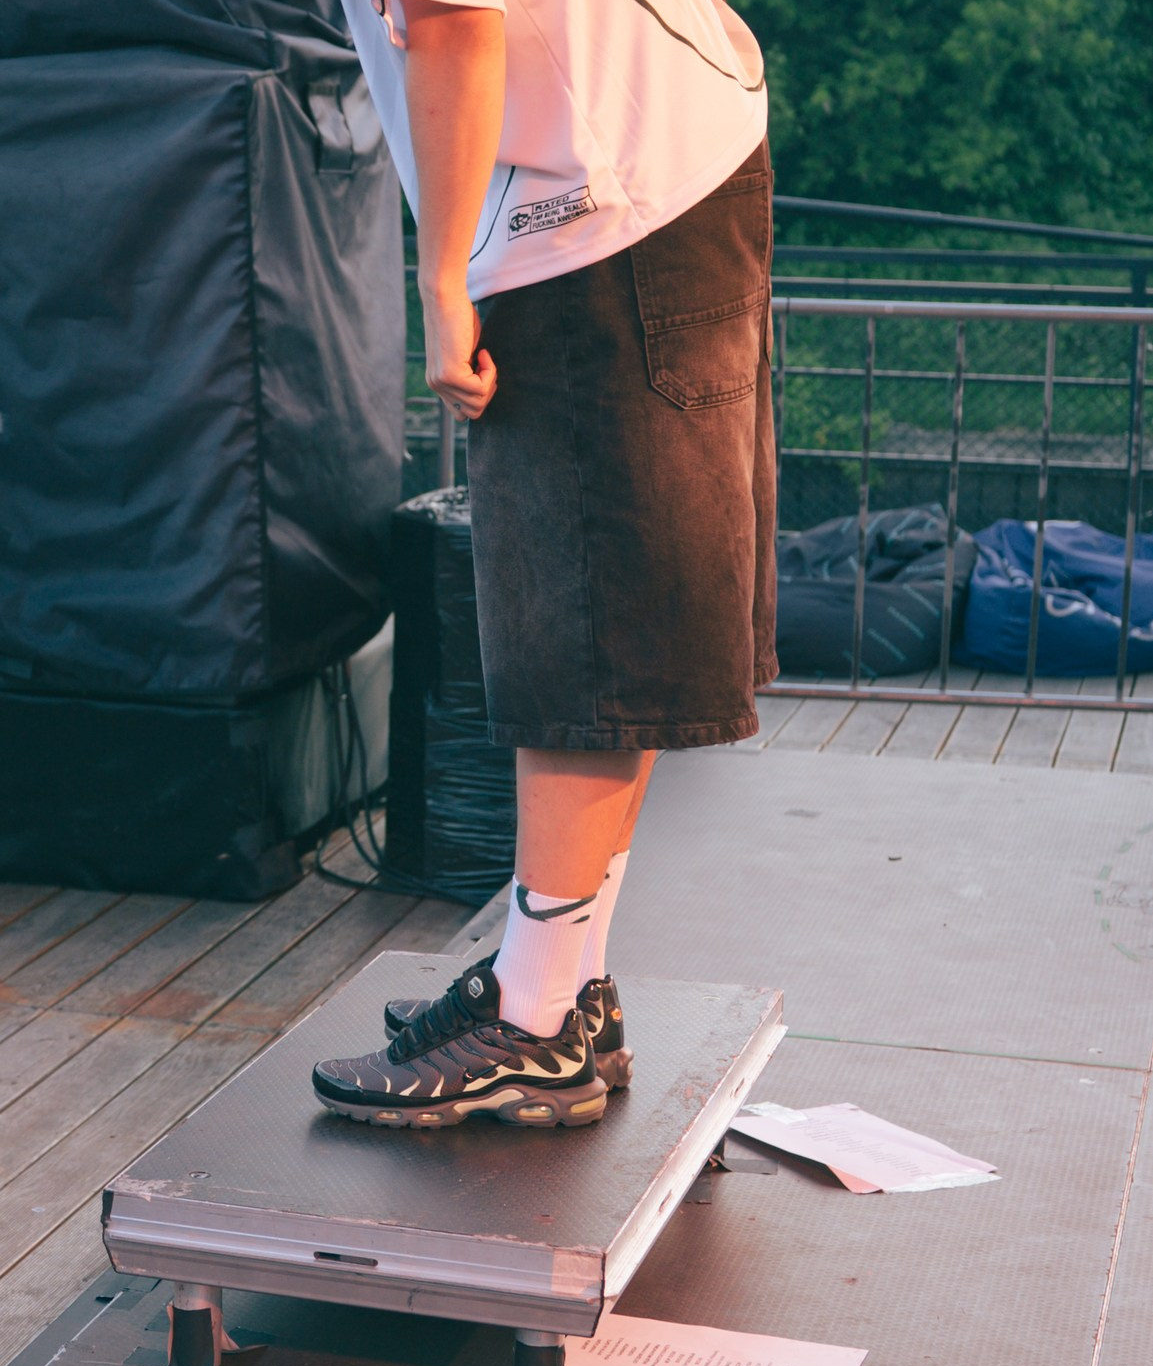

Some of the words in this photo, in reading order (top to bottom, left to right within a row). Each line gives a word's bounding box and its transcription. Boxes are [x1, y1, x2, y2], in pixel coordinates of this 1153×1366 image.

[535, 196, 570, 212] RATED
[544, 208, 560, 219] BEING
[563, 200, 588, 212] REALLY
[532, 218, 556, 230] FUCKING
[557, 208, 590, 224] AWESOME
